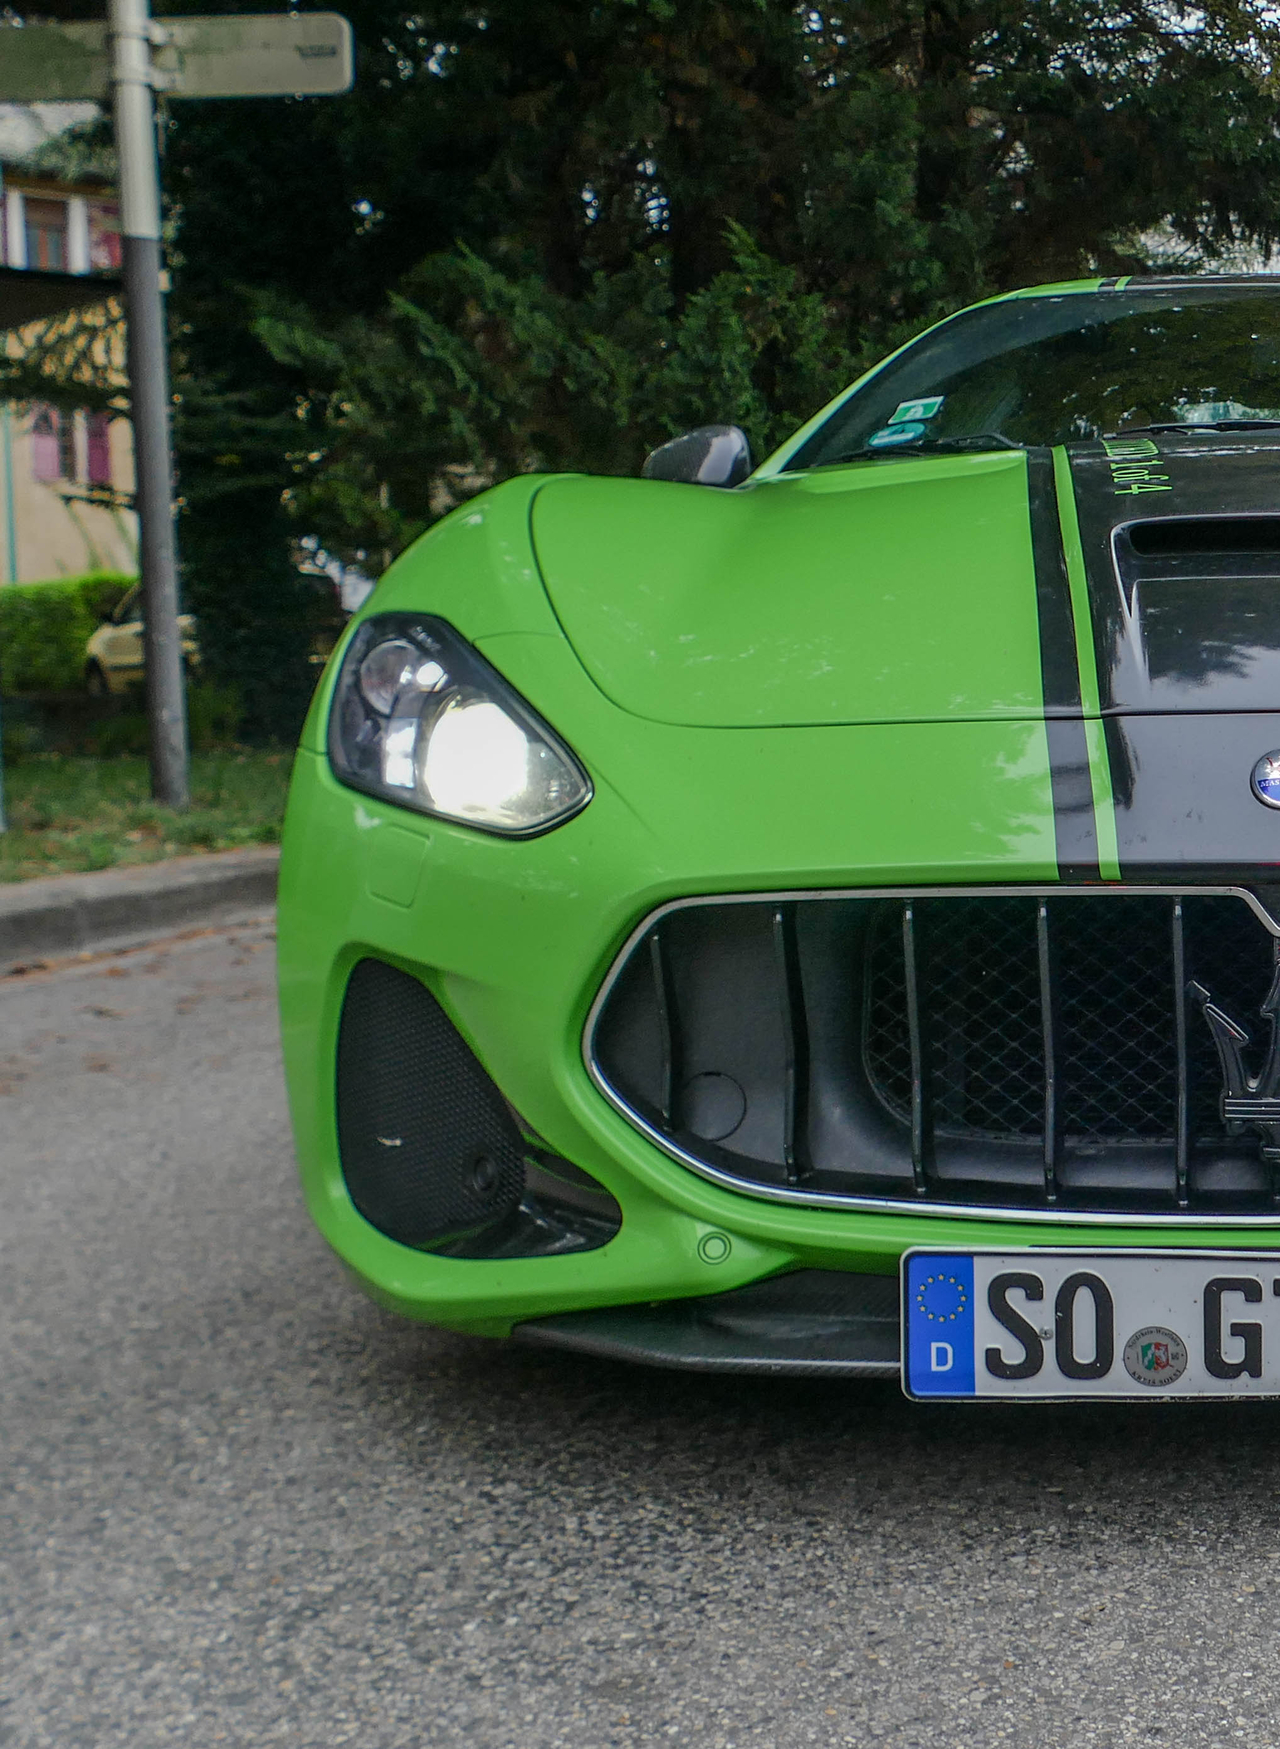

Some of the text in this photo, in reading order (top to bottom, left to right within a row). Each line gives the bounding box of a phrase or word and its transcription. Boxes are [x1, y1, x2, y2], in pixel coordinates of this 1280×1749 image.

[1110, 460, 1164, 470] 1
[1112, 469, 1169, 482] of
[1114, 483, 1173, 494] 4
[985, 1271, 1114, 1380] SO
[931, 1341, 953, 1373] D
